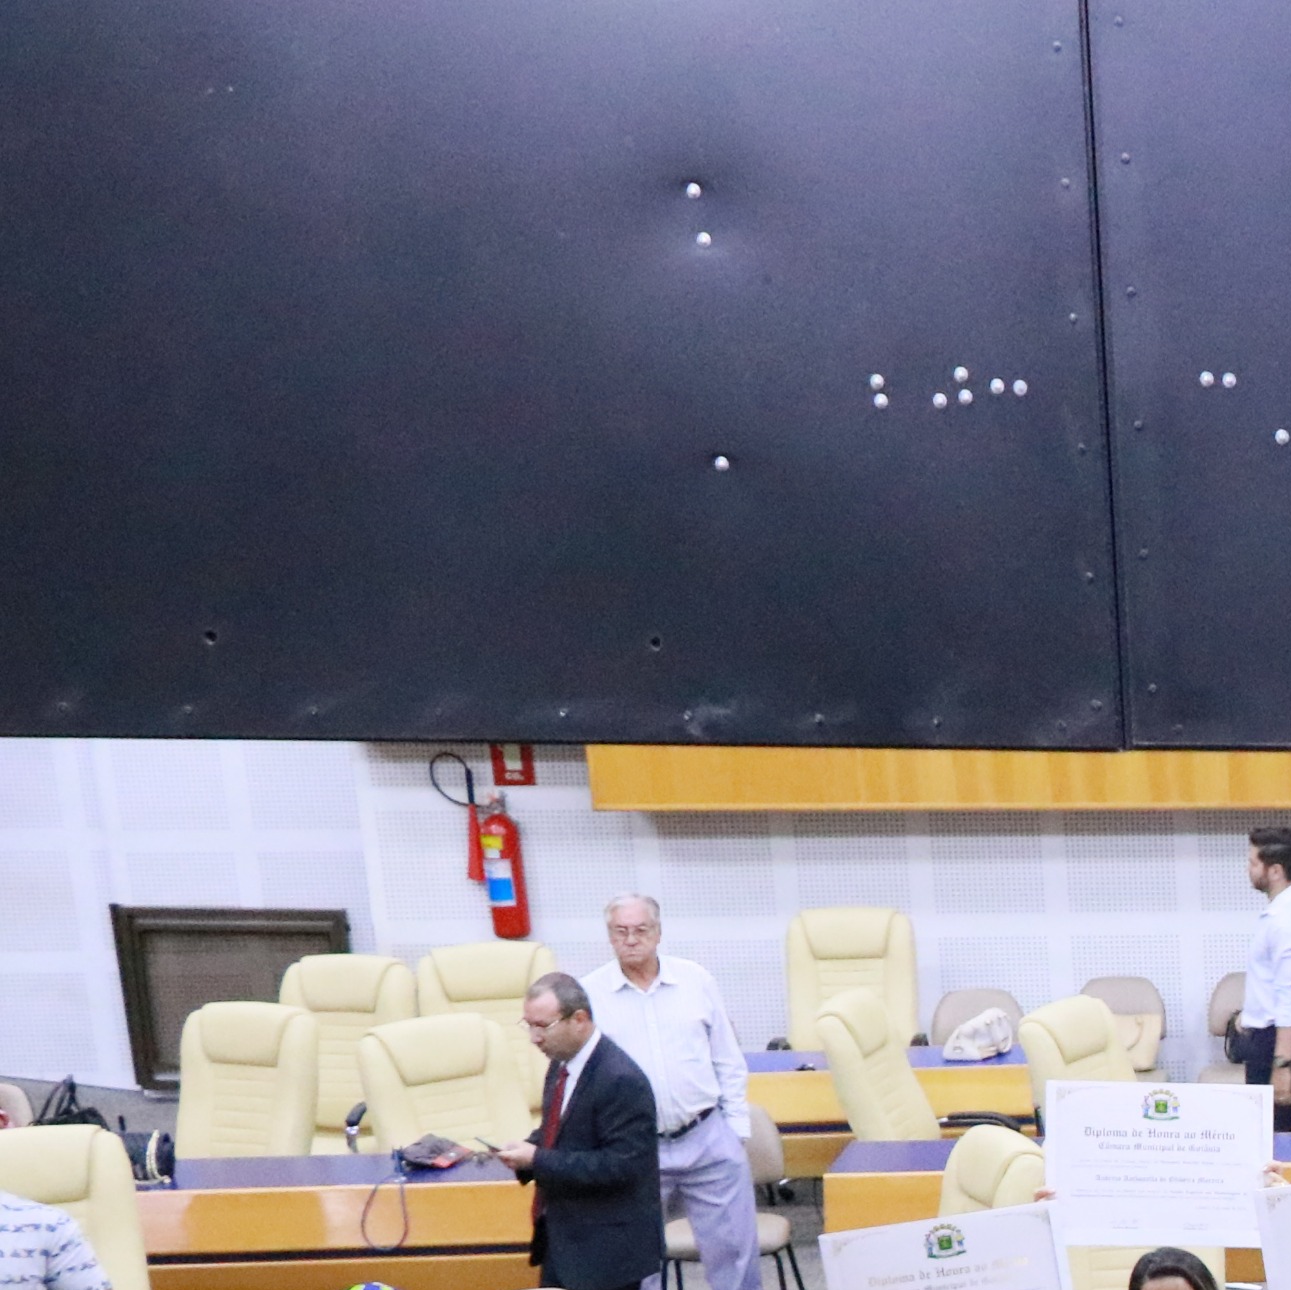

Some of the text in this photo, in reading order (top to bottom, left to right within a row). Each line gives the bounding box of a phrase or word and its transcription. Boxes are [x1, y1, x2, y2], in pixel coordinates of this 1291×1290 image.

[1083, 1126, 1235, 1140] Diploma de Honra ao Mérito
[918, 1269, 930, 1280] de
[935, 1266, 970, 1277] Honra
